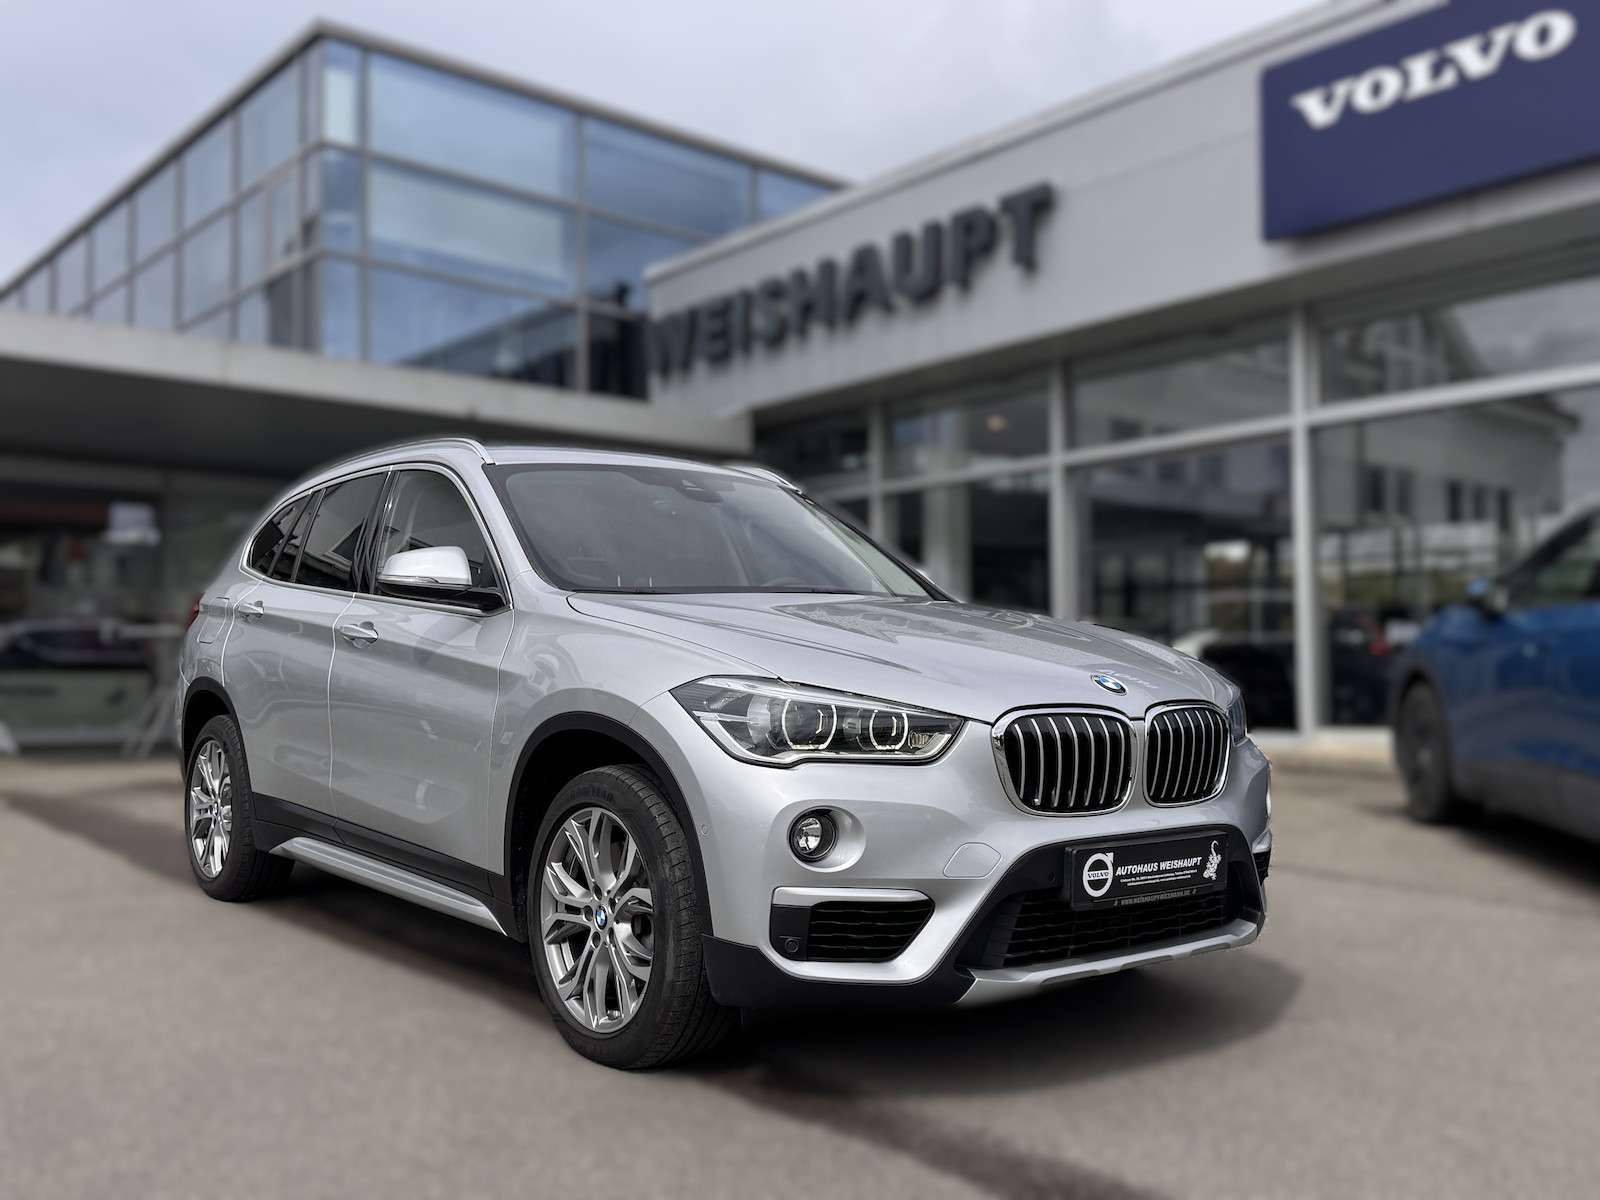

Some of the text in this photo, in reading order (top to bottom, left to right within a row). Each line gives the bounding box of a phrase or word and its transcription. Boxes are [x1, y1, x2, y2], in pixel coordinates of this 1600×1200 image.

[1290, 9, 1576, 130] VOLVO
[648, 182, 1057, 380] WEISHAUPT
[1116, 863, 1158, 876] AUTOHAUS
[1159, 857, 1202, 870] WEISHAUPT
